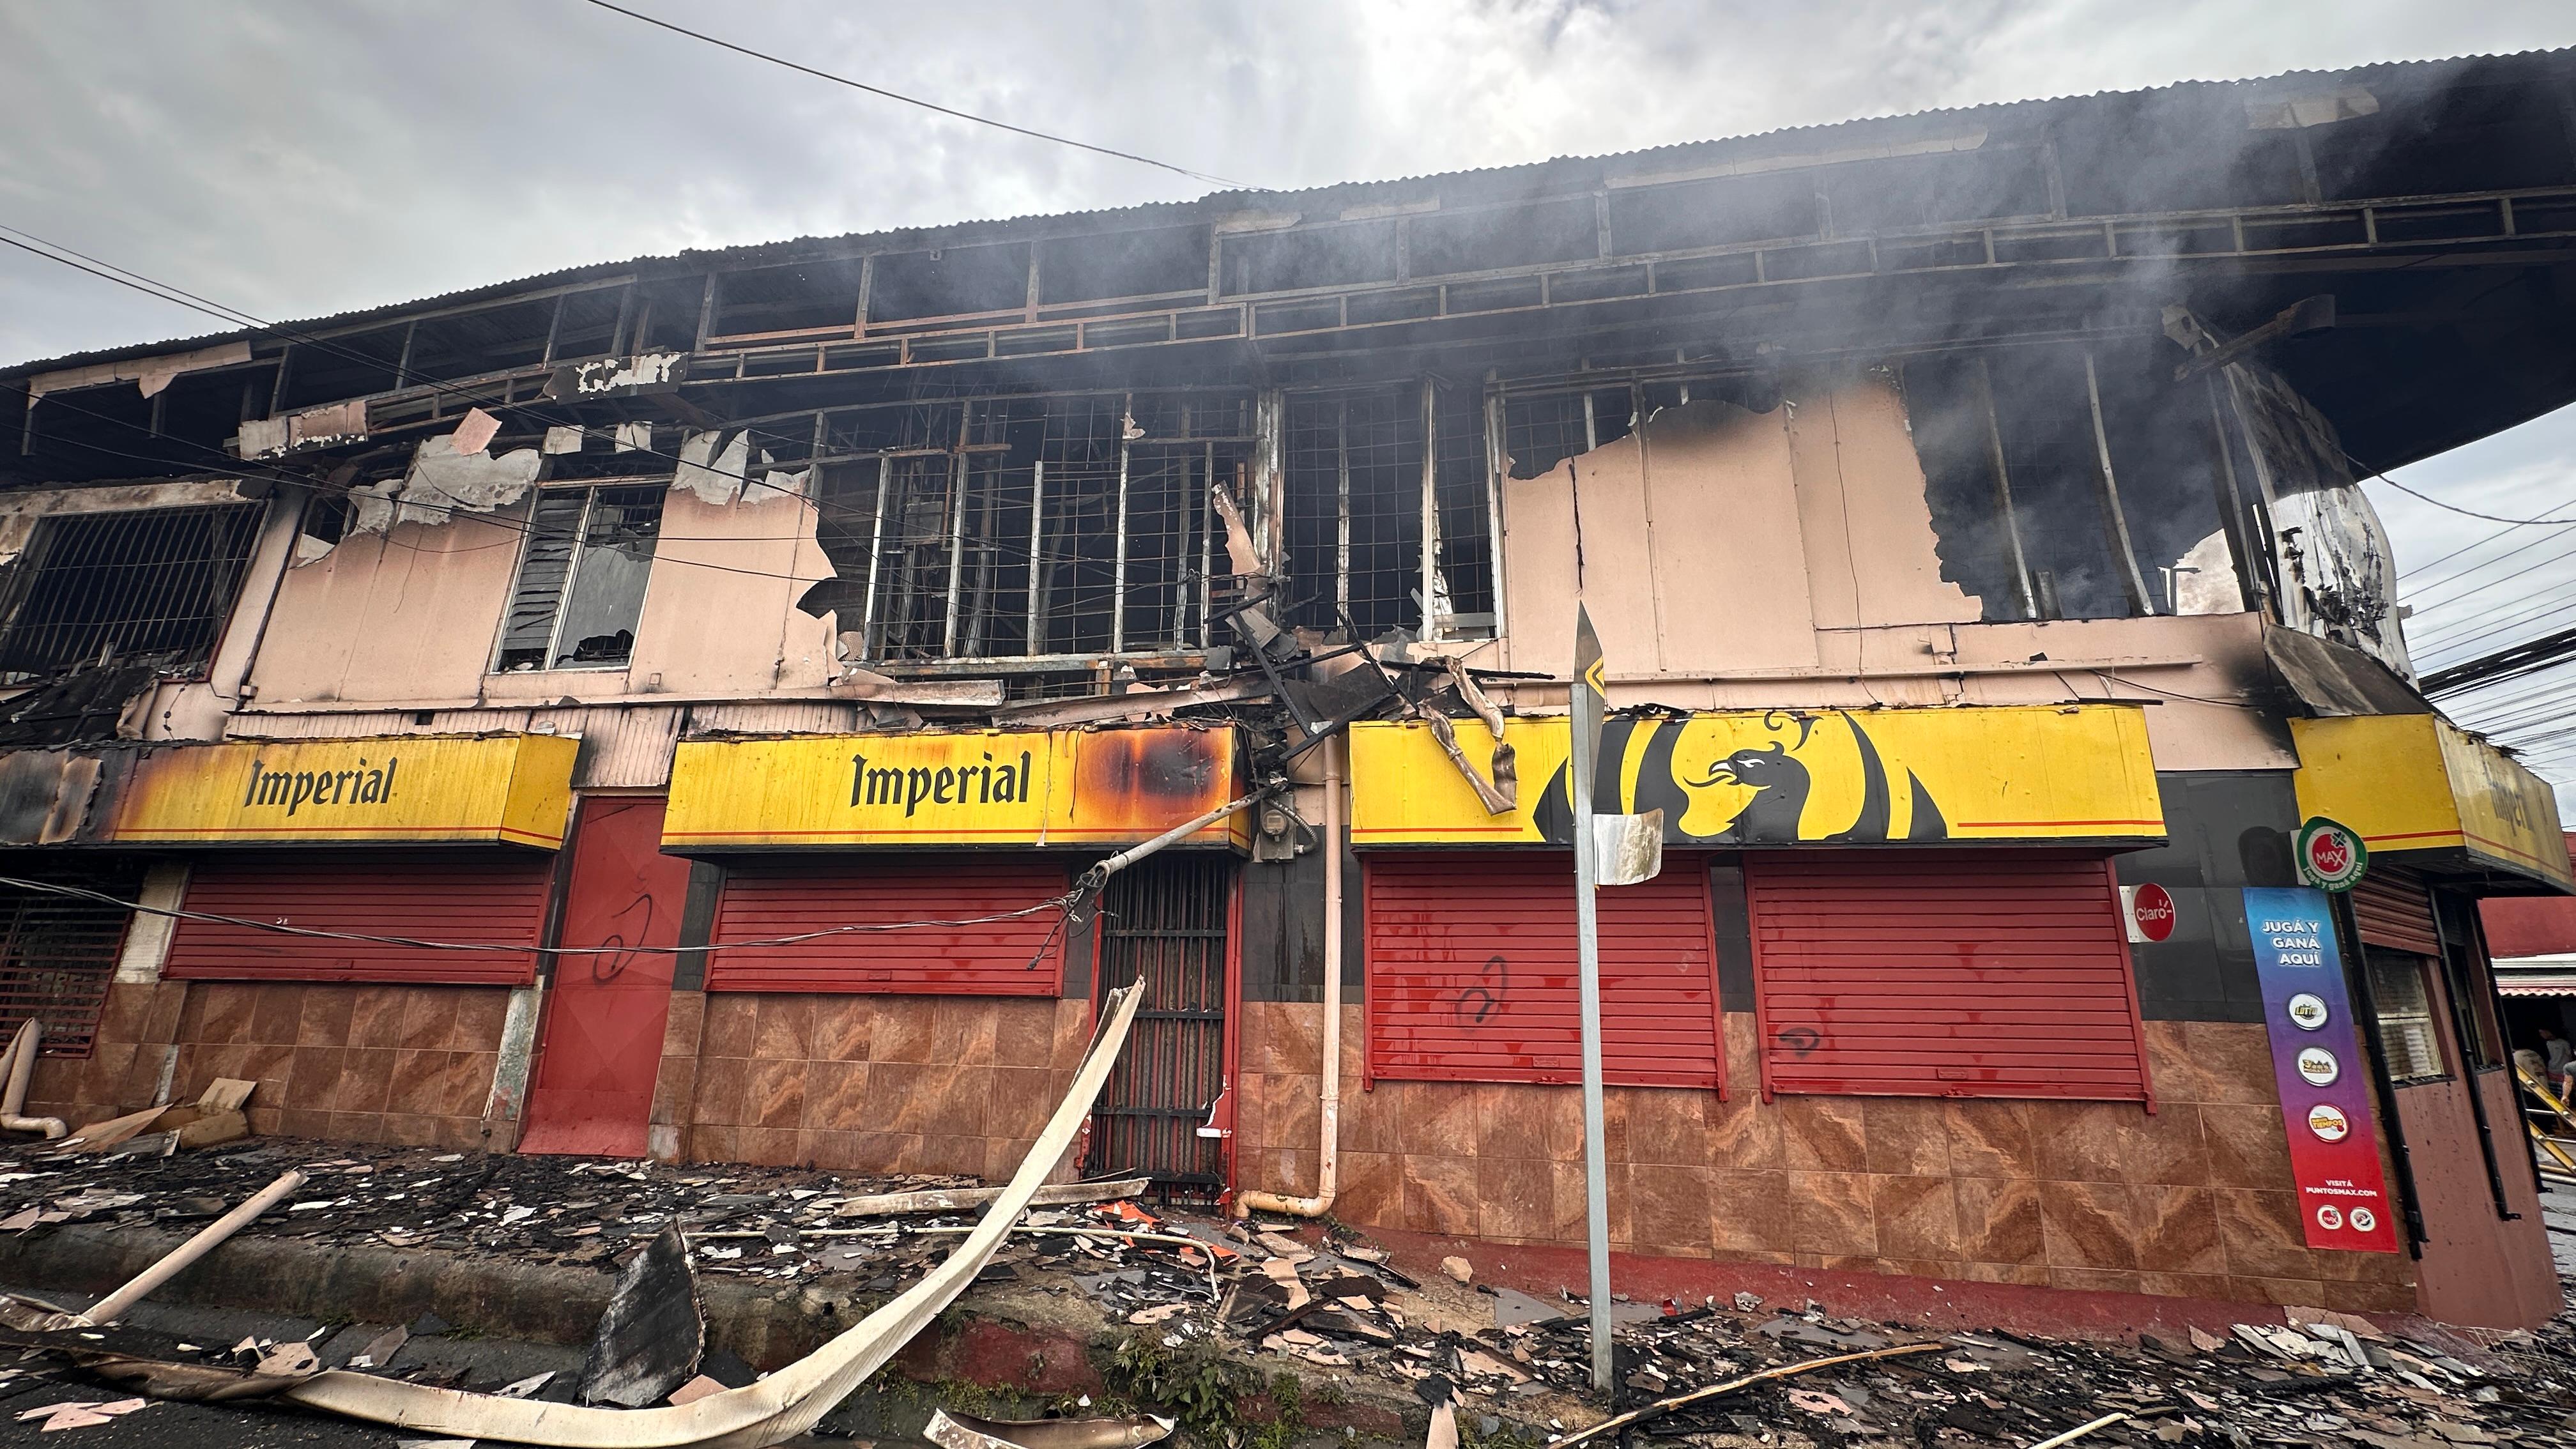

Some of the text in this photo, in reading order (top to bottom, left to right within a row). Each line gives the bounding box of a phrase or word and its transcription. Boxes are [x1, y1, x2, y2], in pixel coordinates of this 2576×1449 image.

[243, 756, 397, 817] Imperial
[850, 750, 1031, 818] Imperial
[2315, 850, 2346, 866] MAX
[2136, 907, 2166, 921] Claro
[2262, 919, 2319, 933] JUGÁ Y
[2273, 935, 2320, 949] GANÁ
[2280, 951, 2320, 965] AQUÍ
[2305, 1186, 2377, 1197] PUNTOSMAX.COM
